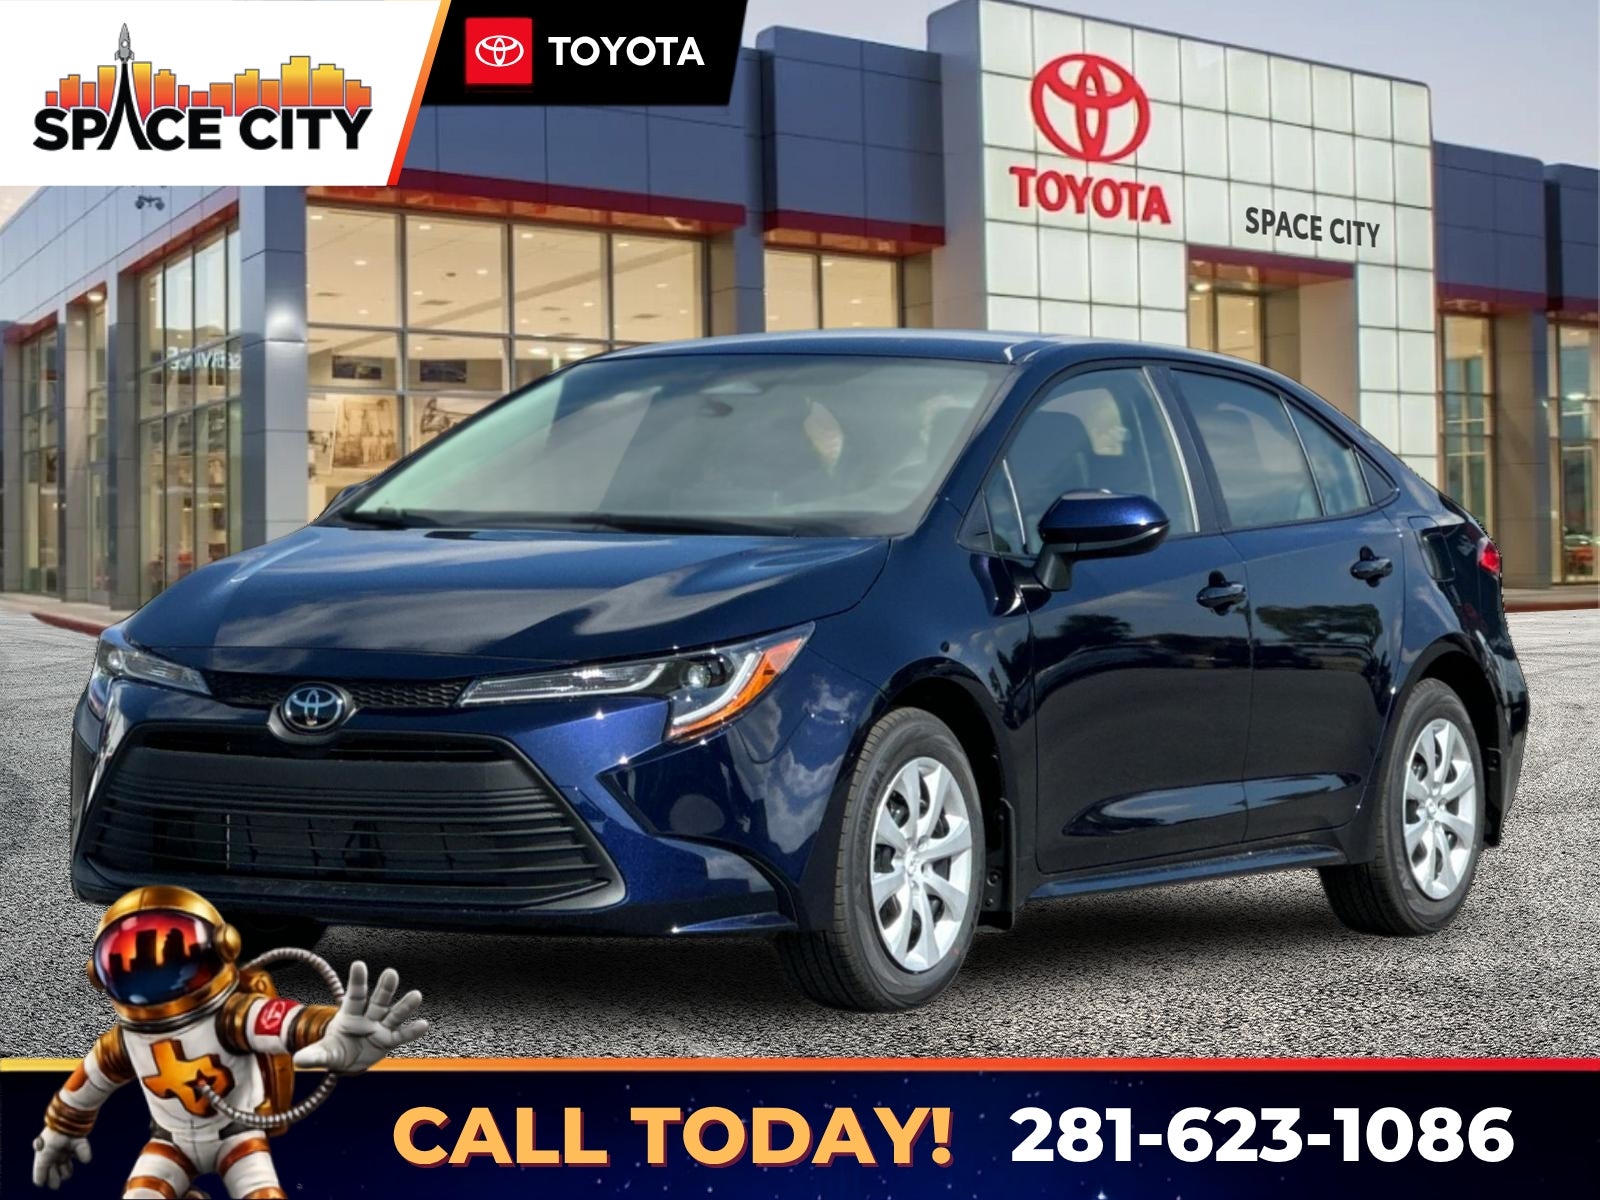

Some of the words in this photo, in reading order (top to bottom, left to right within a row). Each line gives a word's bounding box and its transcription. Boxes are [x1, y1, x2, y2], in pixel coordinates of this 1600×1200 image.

[1009, 166, 1171, 225] TOYOTA
[1244, 206, 1323, 242] SPACE
[1329, 217, 1381, 249] CITY
